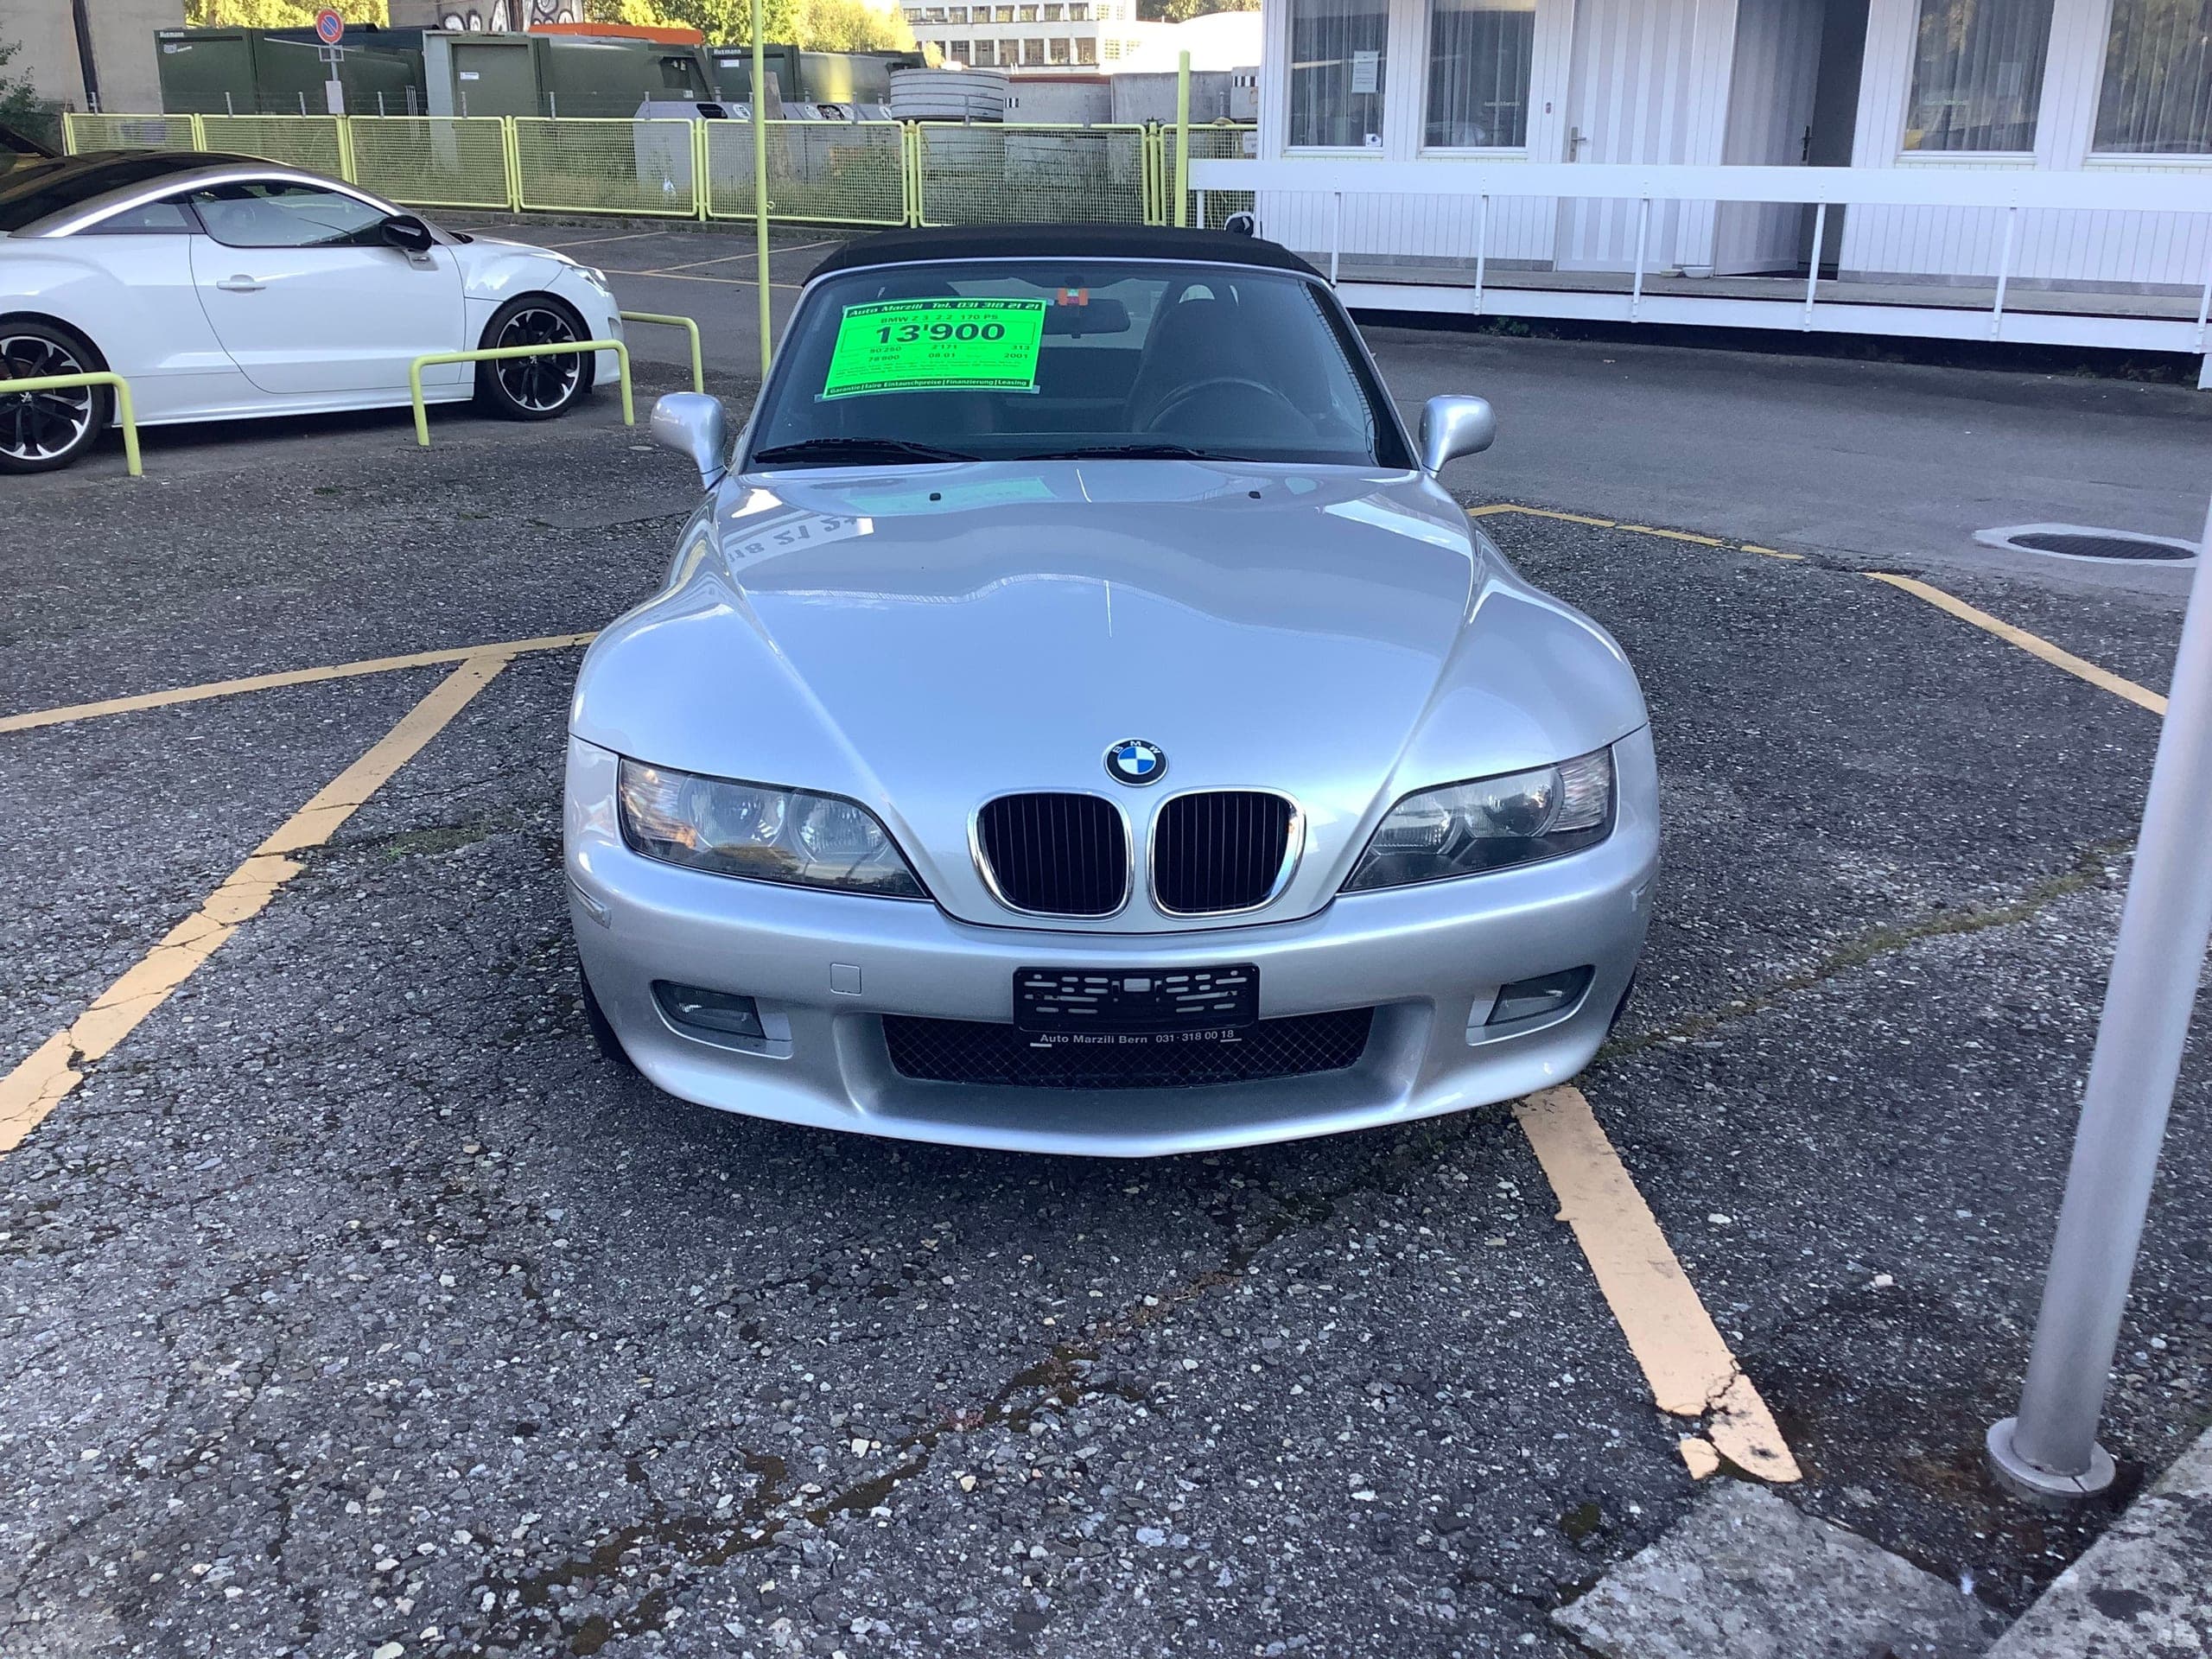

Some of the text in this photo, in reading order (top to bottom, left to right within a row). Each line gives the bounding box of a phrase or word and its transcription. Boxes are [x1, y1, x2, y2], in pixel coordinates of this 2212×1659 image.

[849, 308, 878, 317] Auto
[881, 303, 924, 312] Marzili
[880, 315, 908, 324] BMW
[875, 322, 1006, 344] 13'900
[1112, 741, 1162, 754] BMW
[1039, 1033, 1069, 1044] Auto
[1073, 1033, 1115, 1045] Marzili
[1119, 1034, 1148, 1045] Bern
[1204, 1030, 1218, 1041] 00
[1220, 1028, 1235, 1039] 18
